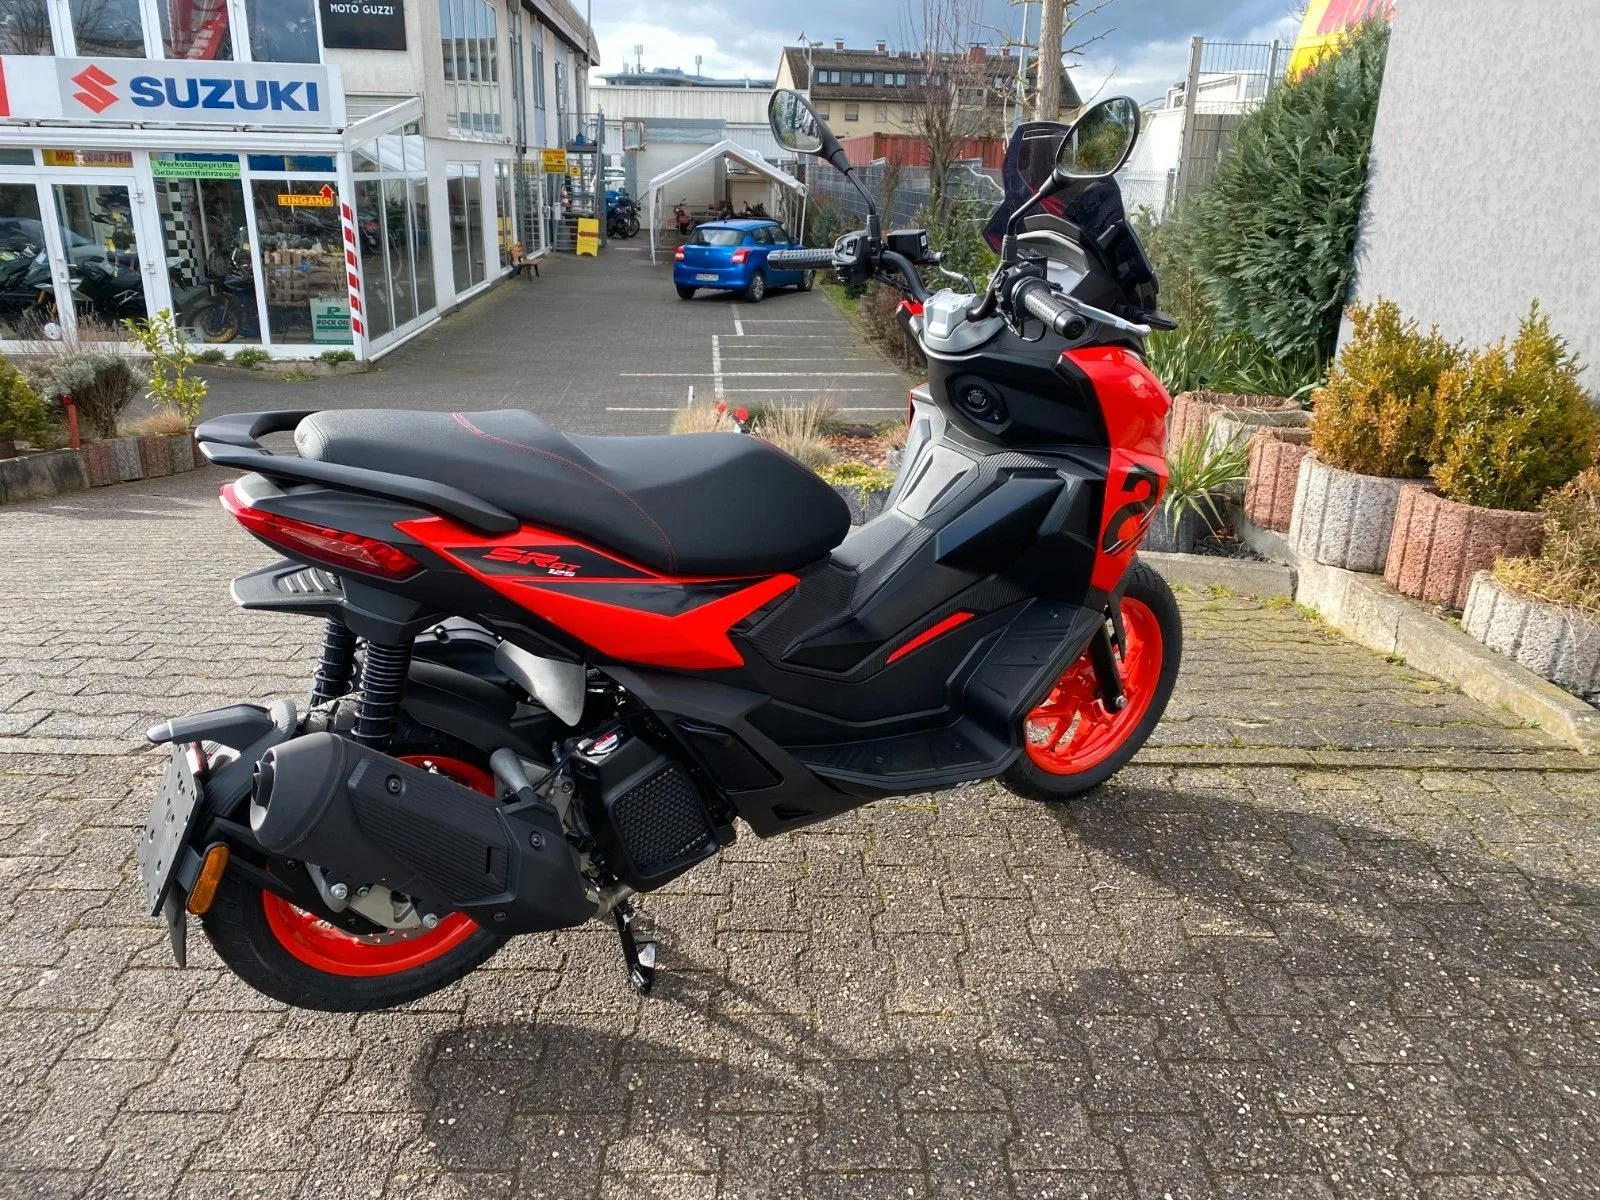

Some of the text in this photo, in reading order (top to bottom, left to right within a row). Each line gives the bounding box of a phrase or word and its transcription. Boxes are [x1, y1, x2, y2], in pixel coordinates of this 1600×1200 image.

[330, 4, 394, 15] MOTO GUZZI
[129, 76, 320, 112] SUZUKI
[157, 160, 233, 169] Werkstattgeprüfte
[153, 169, 240, 178] Gebrauchtfahrzeuge
[280, 196, 332, 205] EINGANG
[481, 547, 560, 568] SR
[547, 568, 577, 577] 125
